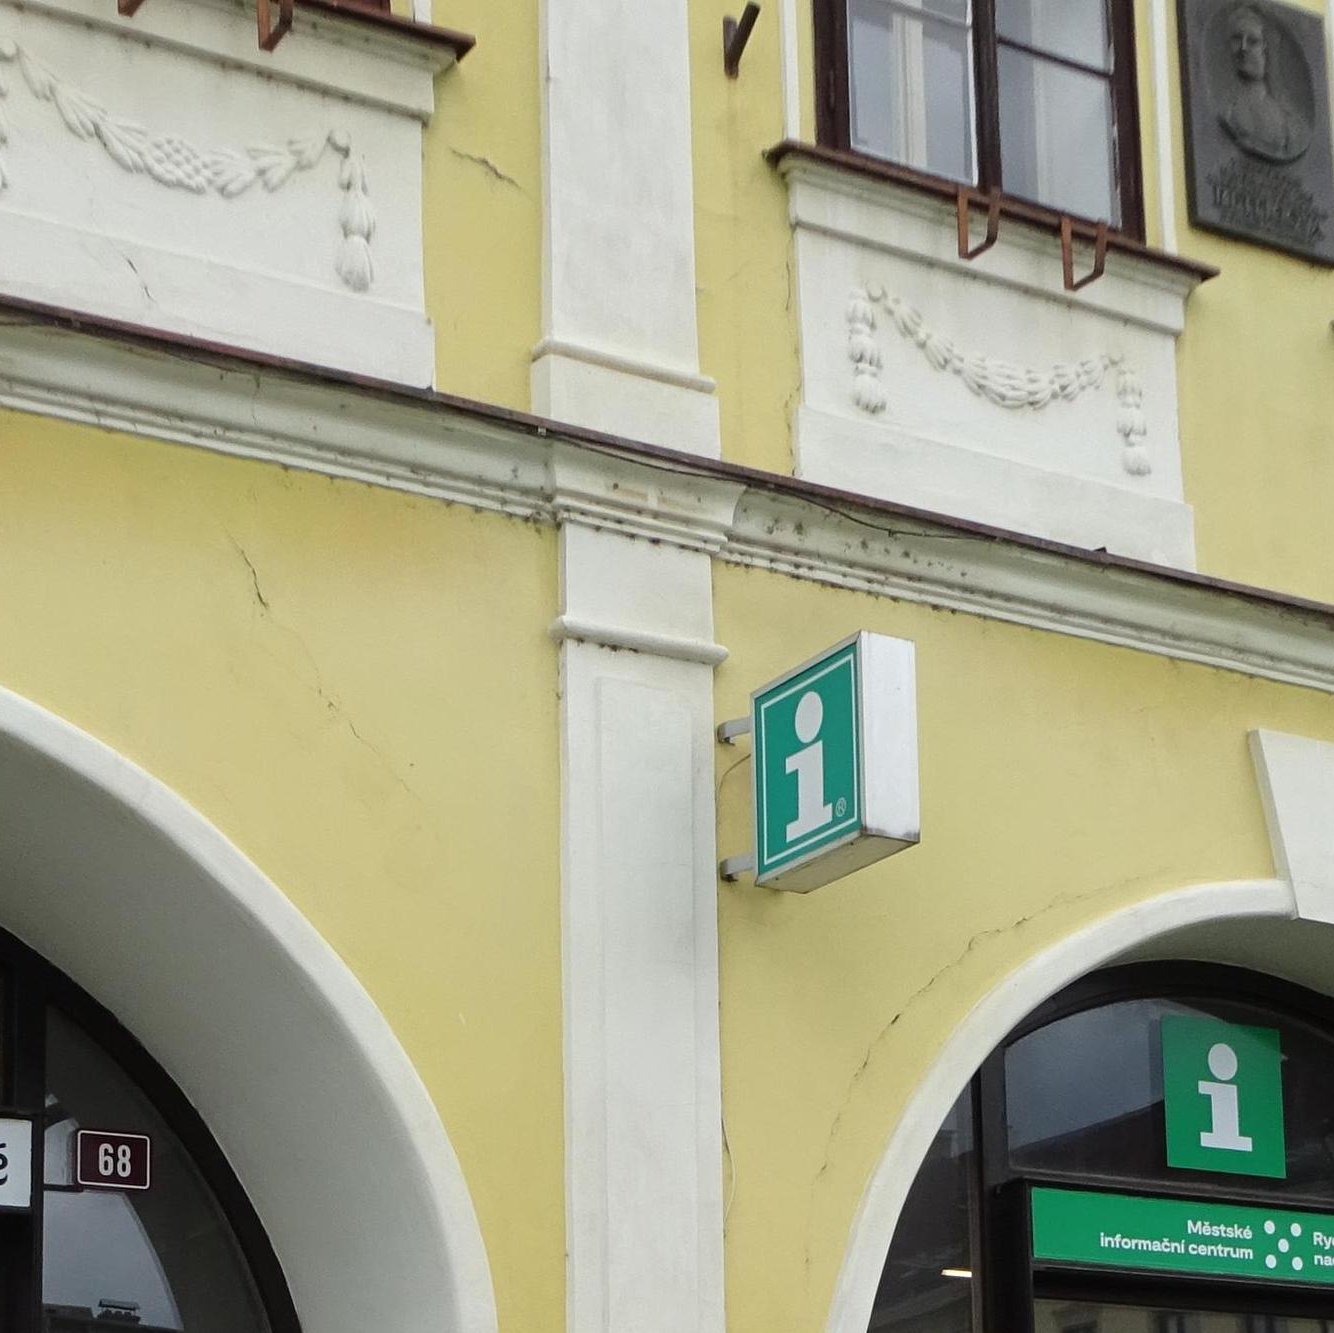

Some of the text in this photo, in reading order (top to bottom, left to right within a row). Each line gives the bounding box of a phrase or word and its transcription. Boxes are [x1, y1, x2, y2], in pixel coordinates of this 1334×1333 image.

[98, 1142, 132, 1179] 68
[1186, 1219, 1253, 1240] Městské
[1100, 1232, 1254, 1260] informační centrum
